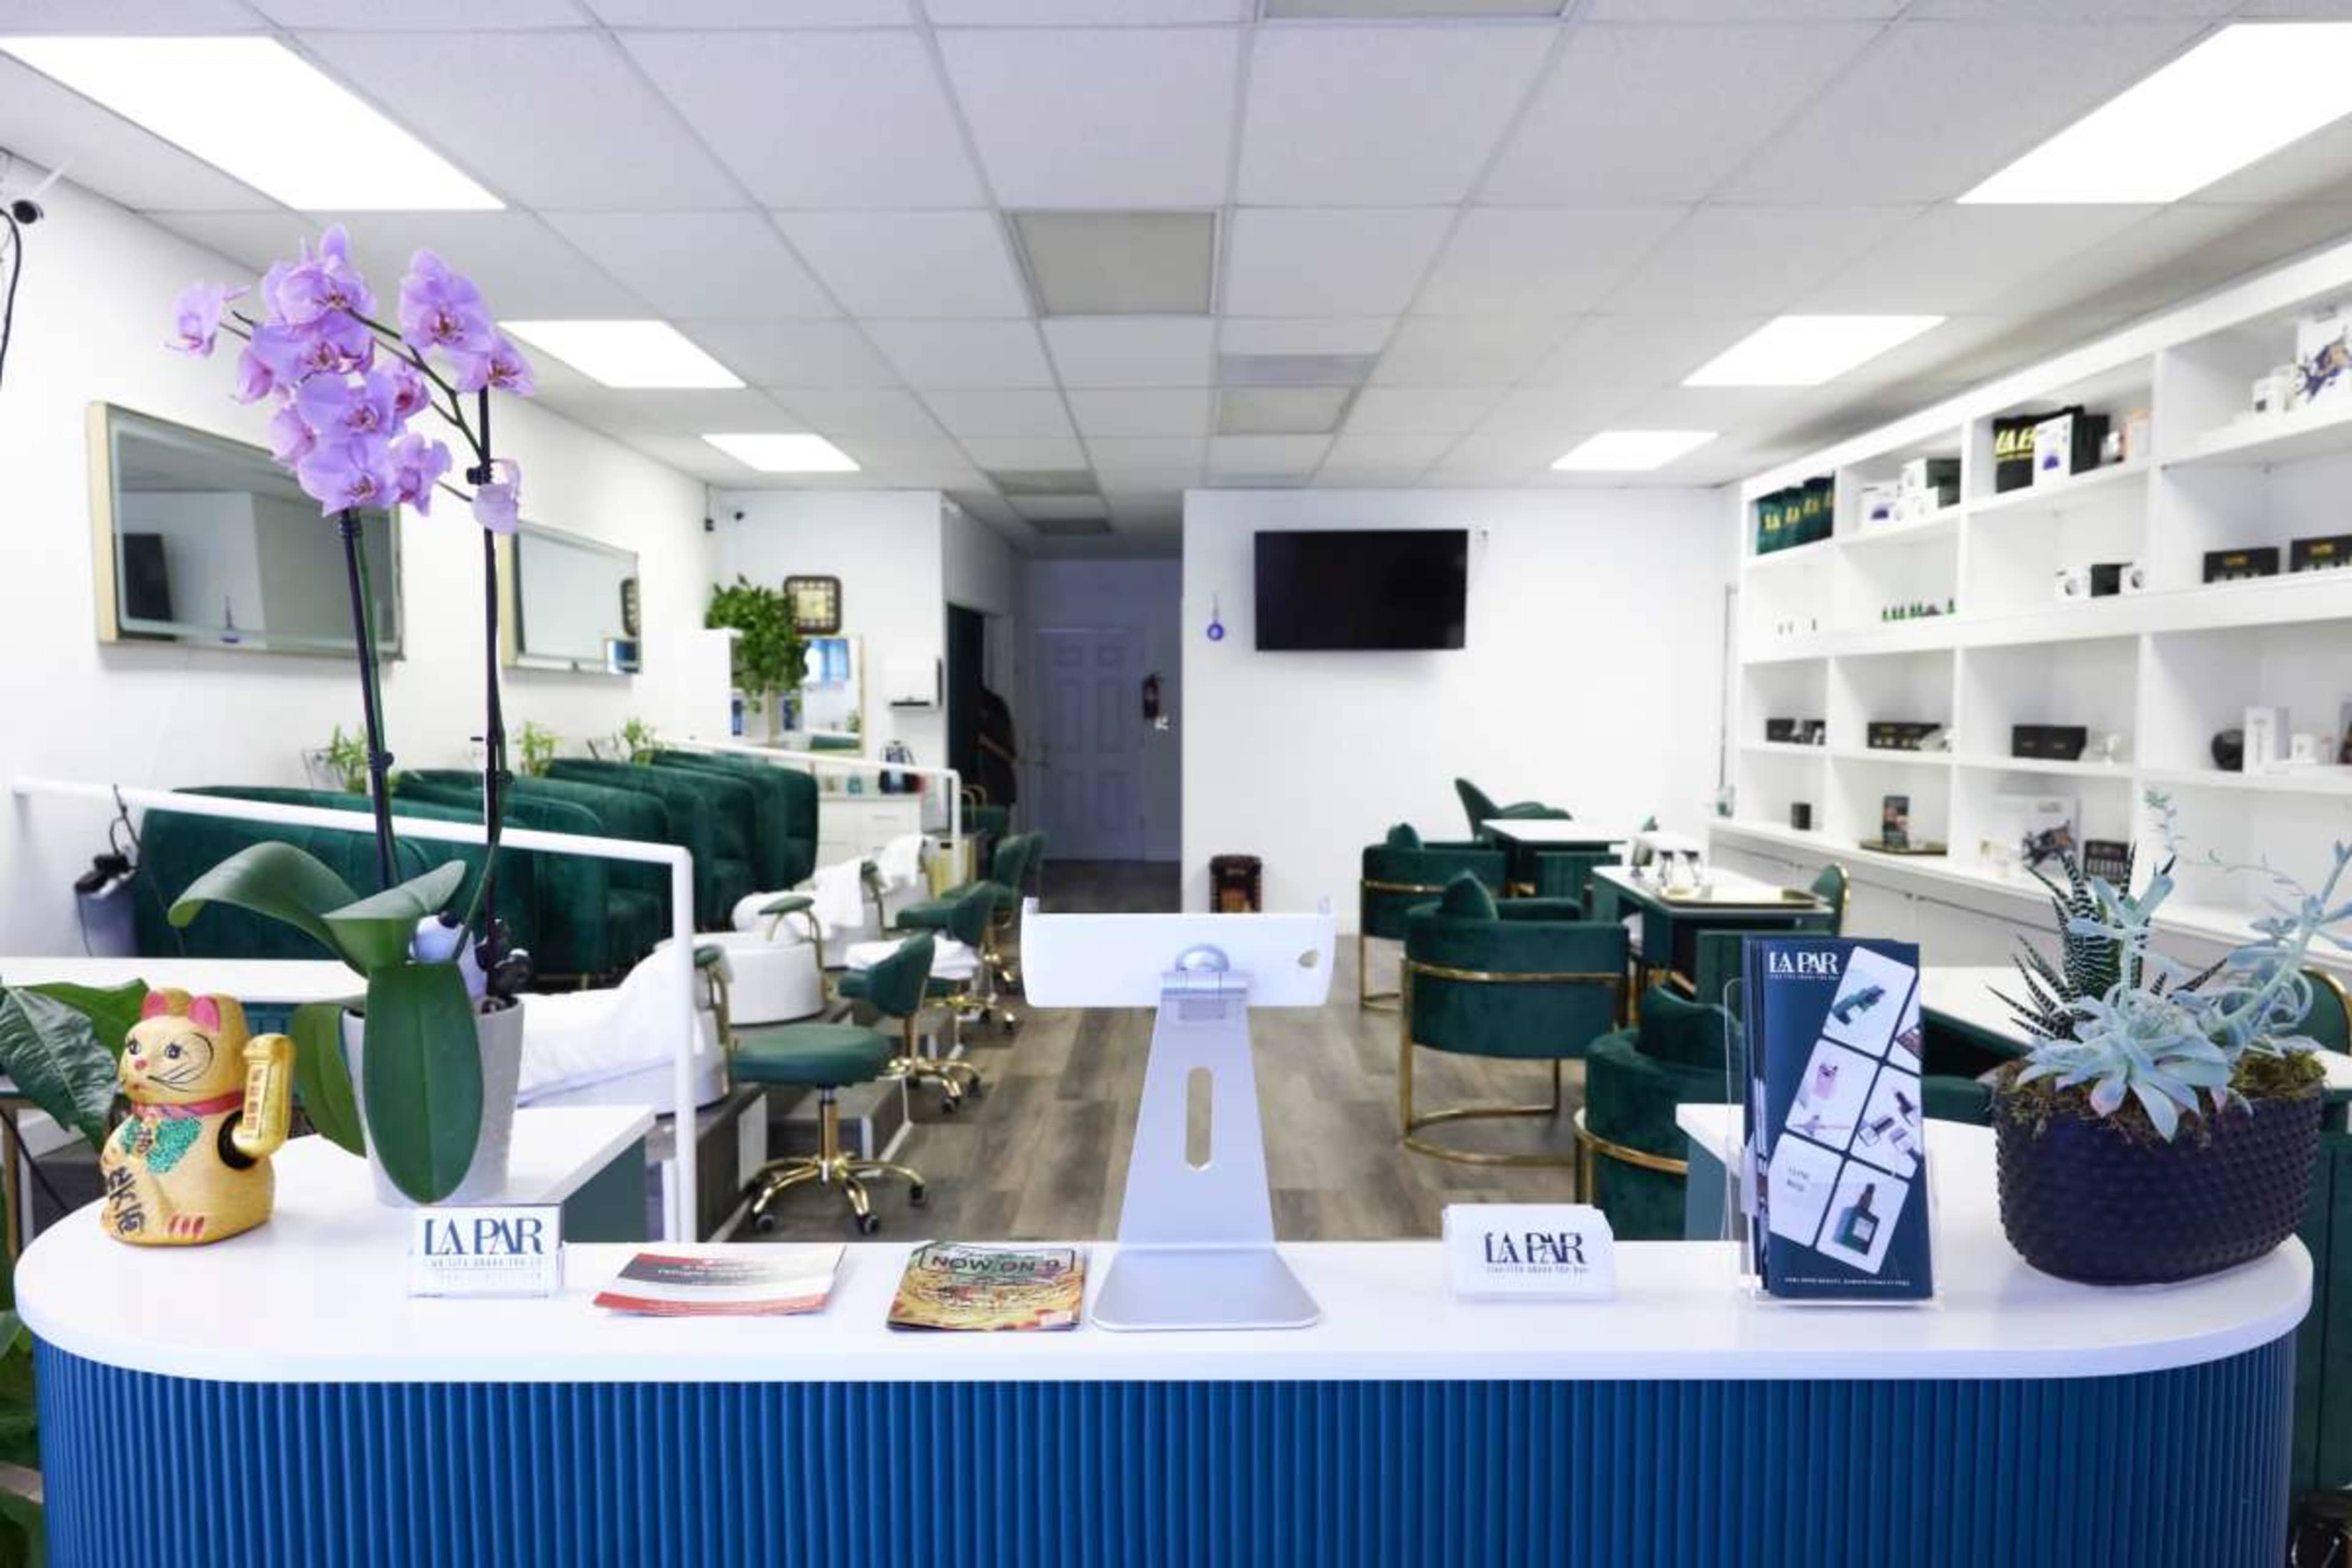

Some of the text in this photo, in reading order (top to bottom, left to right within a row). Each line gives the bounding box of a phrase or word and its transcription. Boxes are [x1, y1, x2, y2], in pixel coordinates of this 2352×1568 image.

[1769, 952, 1839, 974] LA PAR
[424, 1217, 545, 1255] LA PAR
[1485, 1232, 1586, 1264] LA PAR
[932, 1255, 991, 1272] NOW
[1000, 1260, 1036, 1272] ON
